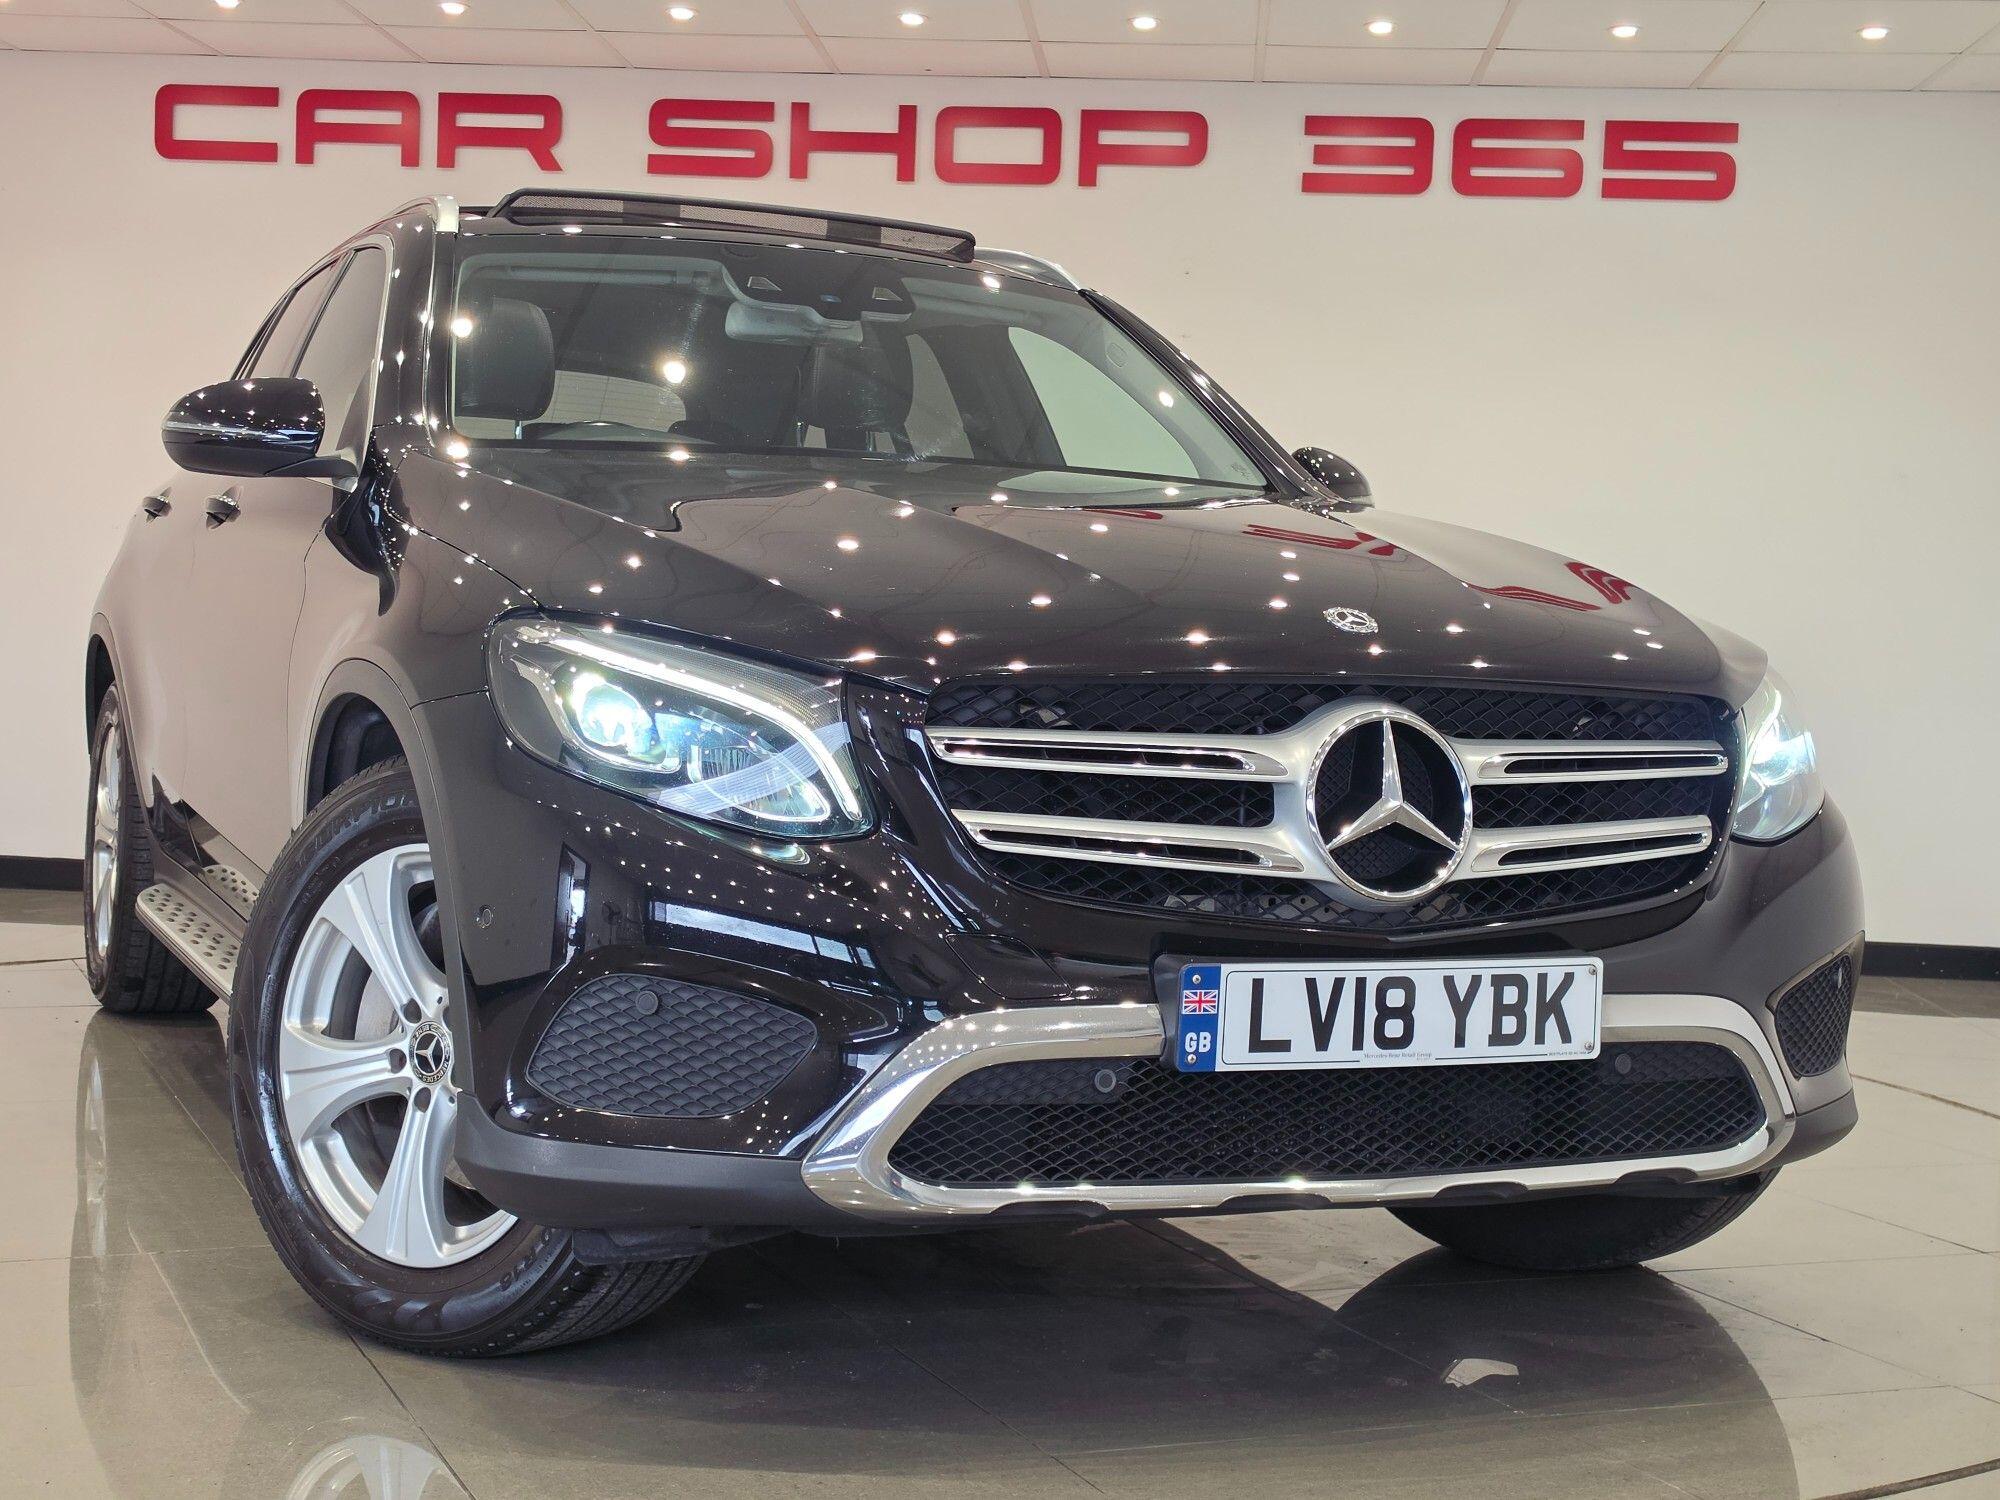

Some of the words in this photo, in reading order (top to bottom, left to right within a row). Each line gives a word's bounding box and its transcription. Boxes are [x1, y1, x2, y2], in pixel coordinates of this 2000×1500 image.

[154, 84, 563, 173] CAR
[647, 98, 1208, 188] SHOP
[1302, 115, 1738, 200] 365
[1184, 1031, 1212, 1053] GB
[1249, 976, 1416, 1054] LV18
[1443, 971, 1575, 1049] YBK
